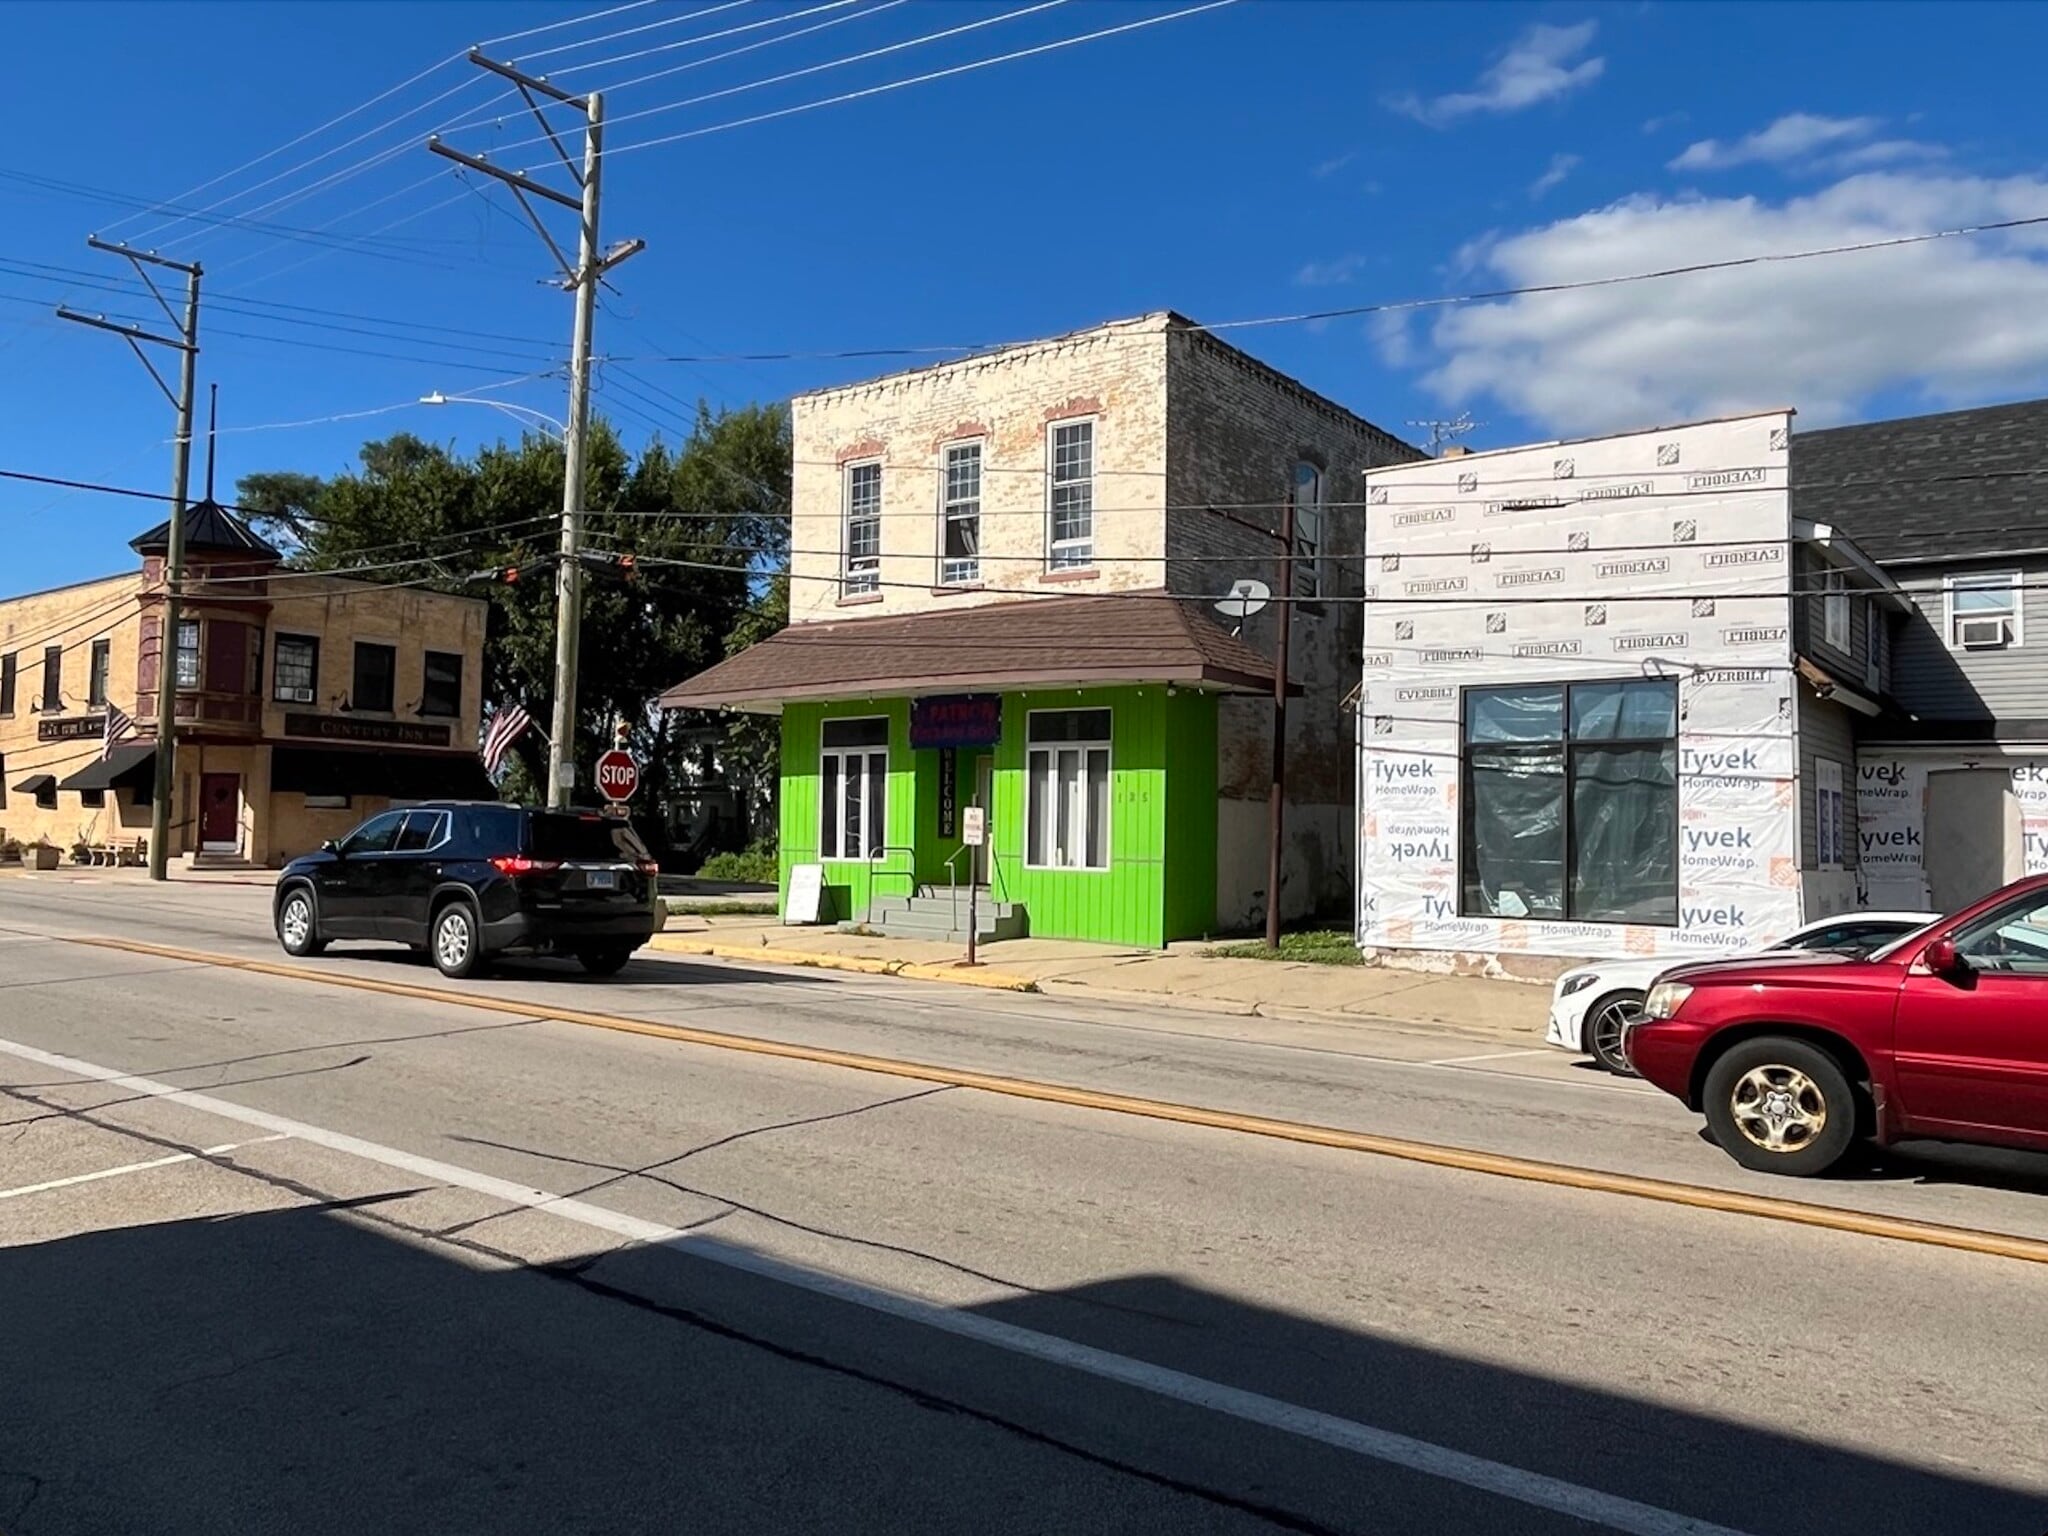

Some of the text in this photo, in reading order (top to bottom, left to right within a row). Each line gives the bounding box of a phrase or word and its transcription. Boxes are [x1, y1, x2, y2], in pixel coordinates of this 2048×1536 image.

[1692, 469, 1762, 488] EVERBILT
[1709, 549, 1779, 565] EVERBILT
[1601, 560, 1666, 576] EVERBILT
[1502, 569, 1562, 585] EVERBILT
[1408, 579, 1465, 594] EVERBILT
[1618, 635, 1685, 650] EVERBILT
[1728, 629, 1787, 642] VERBILT
[1516, 642, 1578, 657] EVERBILT
[1697, 669, 1765, 683] EVERBILT
[1399, 687, 1453, 700] EVERBILT
[1681, 748, 1758, 774] Tyvek
[602, 764, 635, 785] STOP
[1372, 759, 1433, 783] Tyvek
[1857, 762, 1905, 780] vek
[1375, 785, 1437, 796] HomeWrap
[1683, 777, 1760, 791] HomeWrap
[1388, 825, 1450, 836] HomeWrap
[1861, 826, 1921, 852] yvek
[1391, 838, 1454, 862] Tyvek
[1682, 904, 1744, 929] yvek
[1425, 921, 1489, 934] HomeWrap
[1541, 924, 1612, 938] HomeWrap
[1670, 930, 1748, 948] HomeWrap
